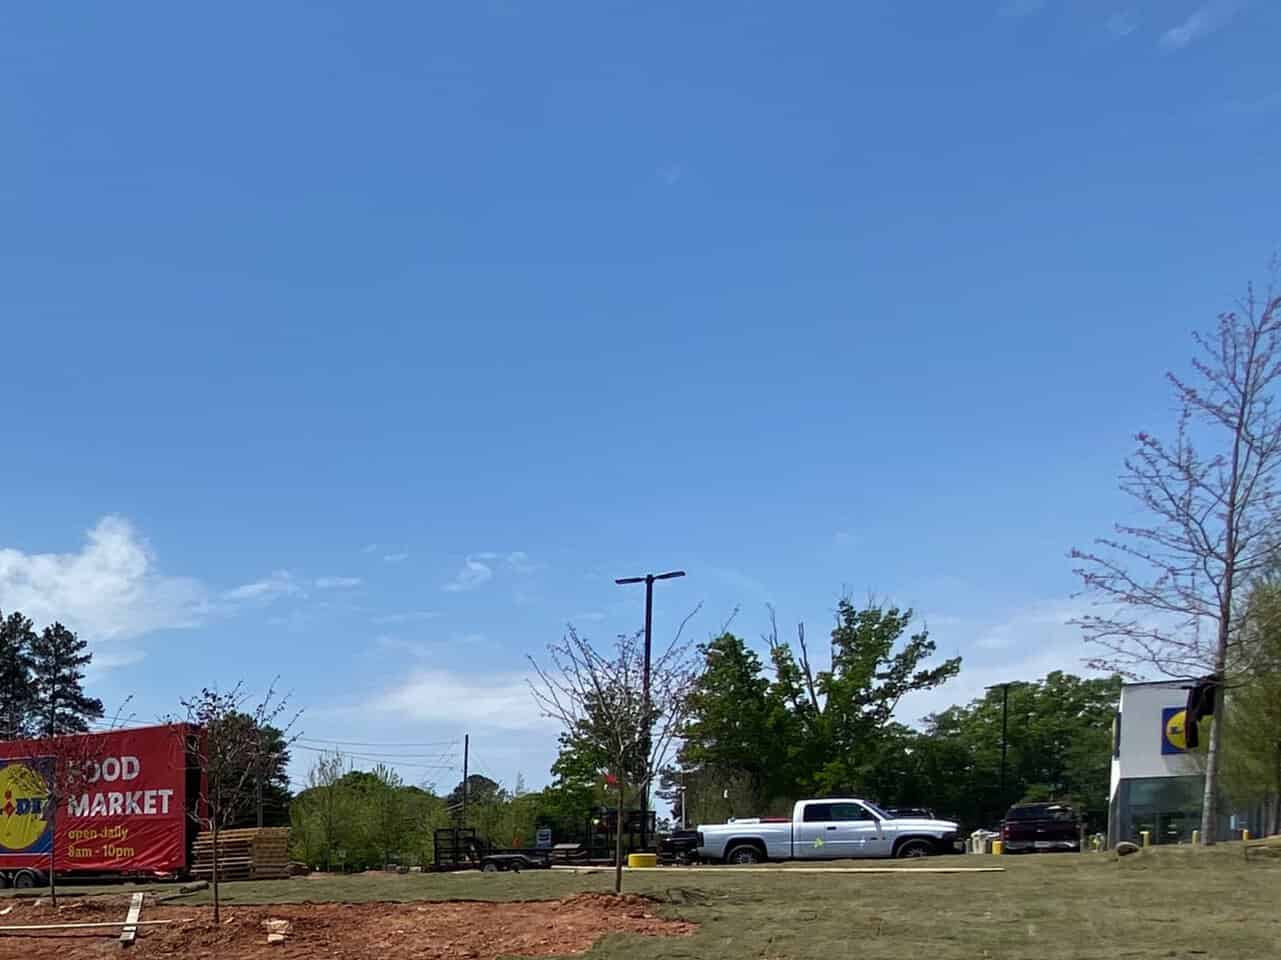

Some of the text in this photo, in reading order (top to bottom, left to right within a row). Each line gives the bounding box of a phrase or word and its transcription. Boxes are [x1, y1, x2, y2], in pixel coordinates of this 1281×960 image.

[68, 789, 174, 817] MARKET
[68, 828, 97, 840] open
[68, 844, 92, 857] 8am
[103, 843, 135, 860] 10pm
